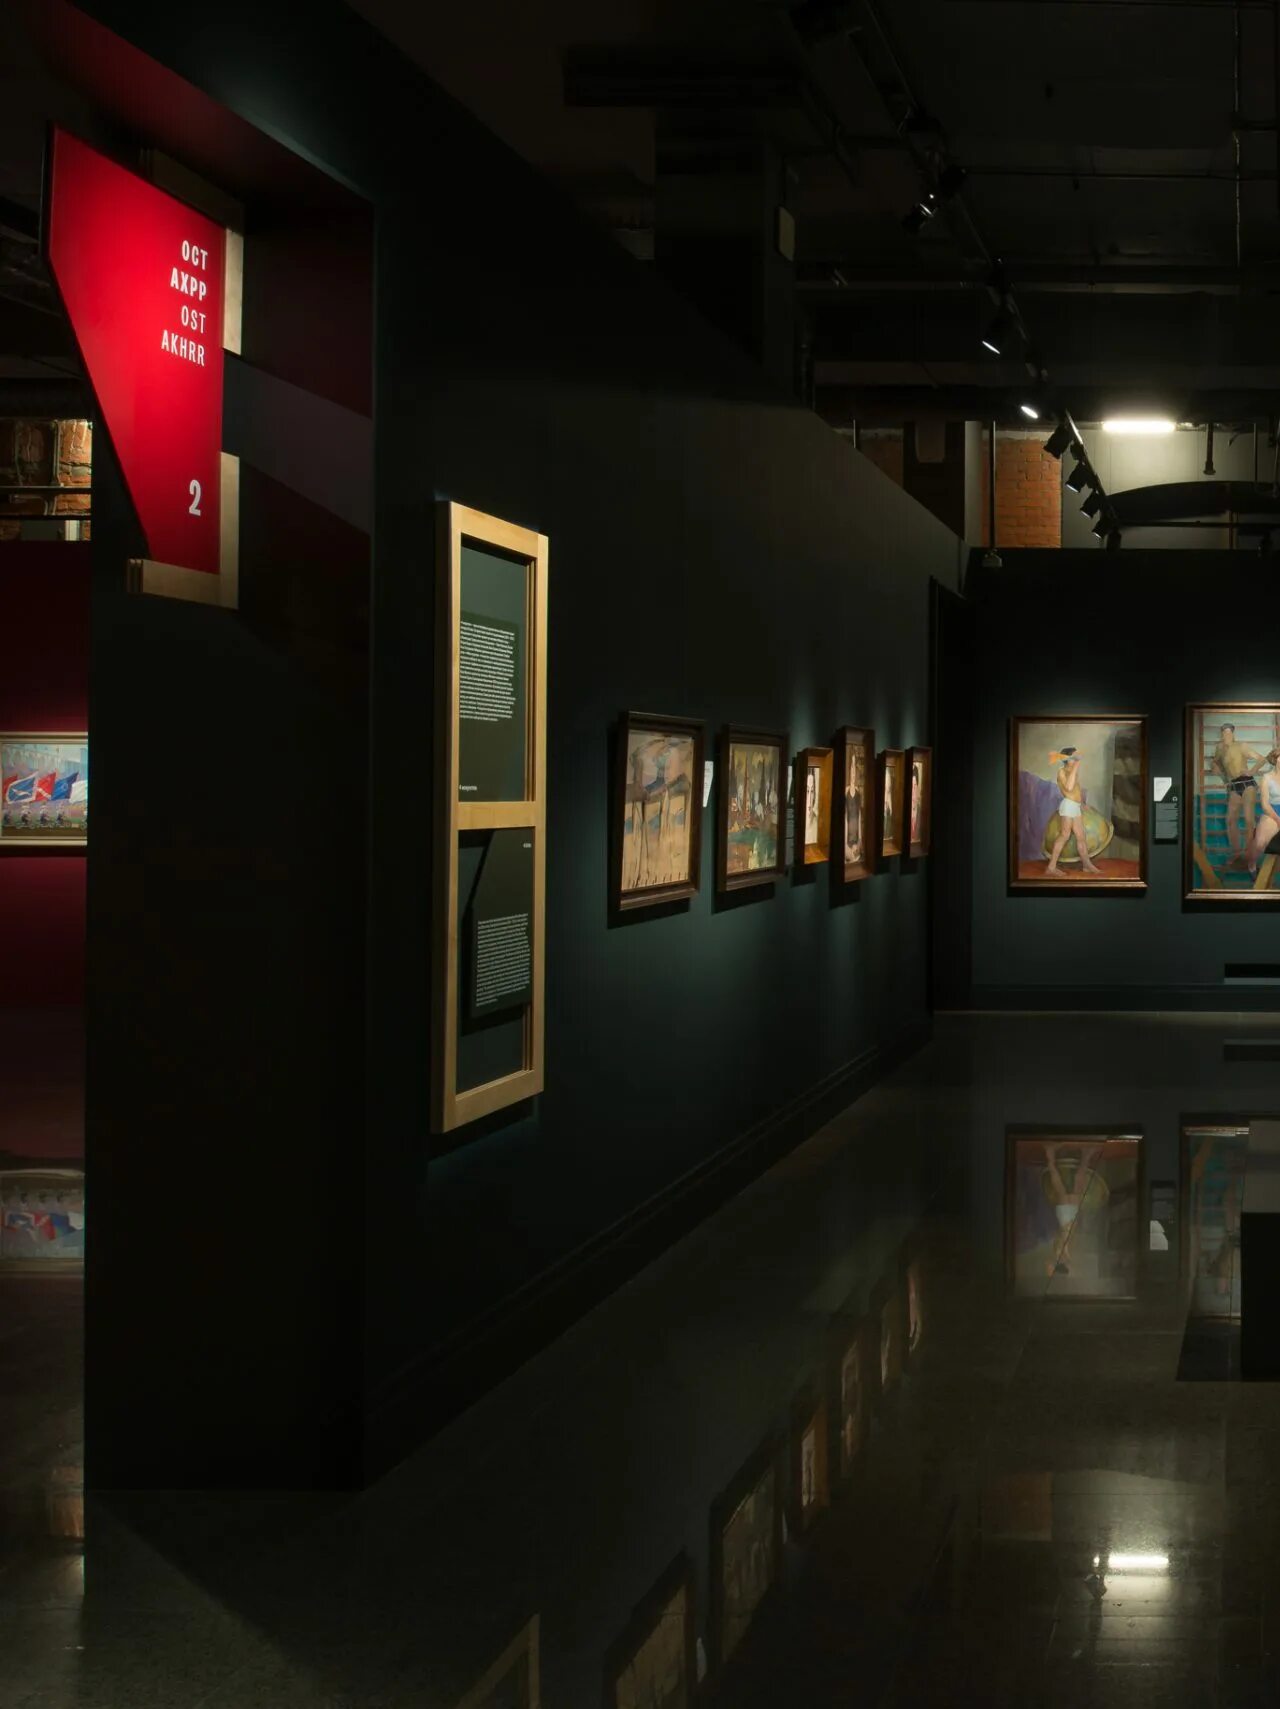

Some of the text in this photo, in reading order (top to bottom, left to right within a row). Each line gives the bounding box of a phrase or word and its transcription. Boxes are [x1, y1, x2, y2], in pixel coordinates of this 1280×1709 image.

[182, 240, 208, 270] ОСТ
[170, 267, 207, 301] АХРР
[181, 305, 206, 334] OST
[161, 329, 205, 367] AKHRR
[189, 479, 201, 516] 2
